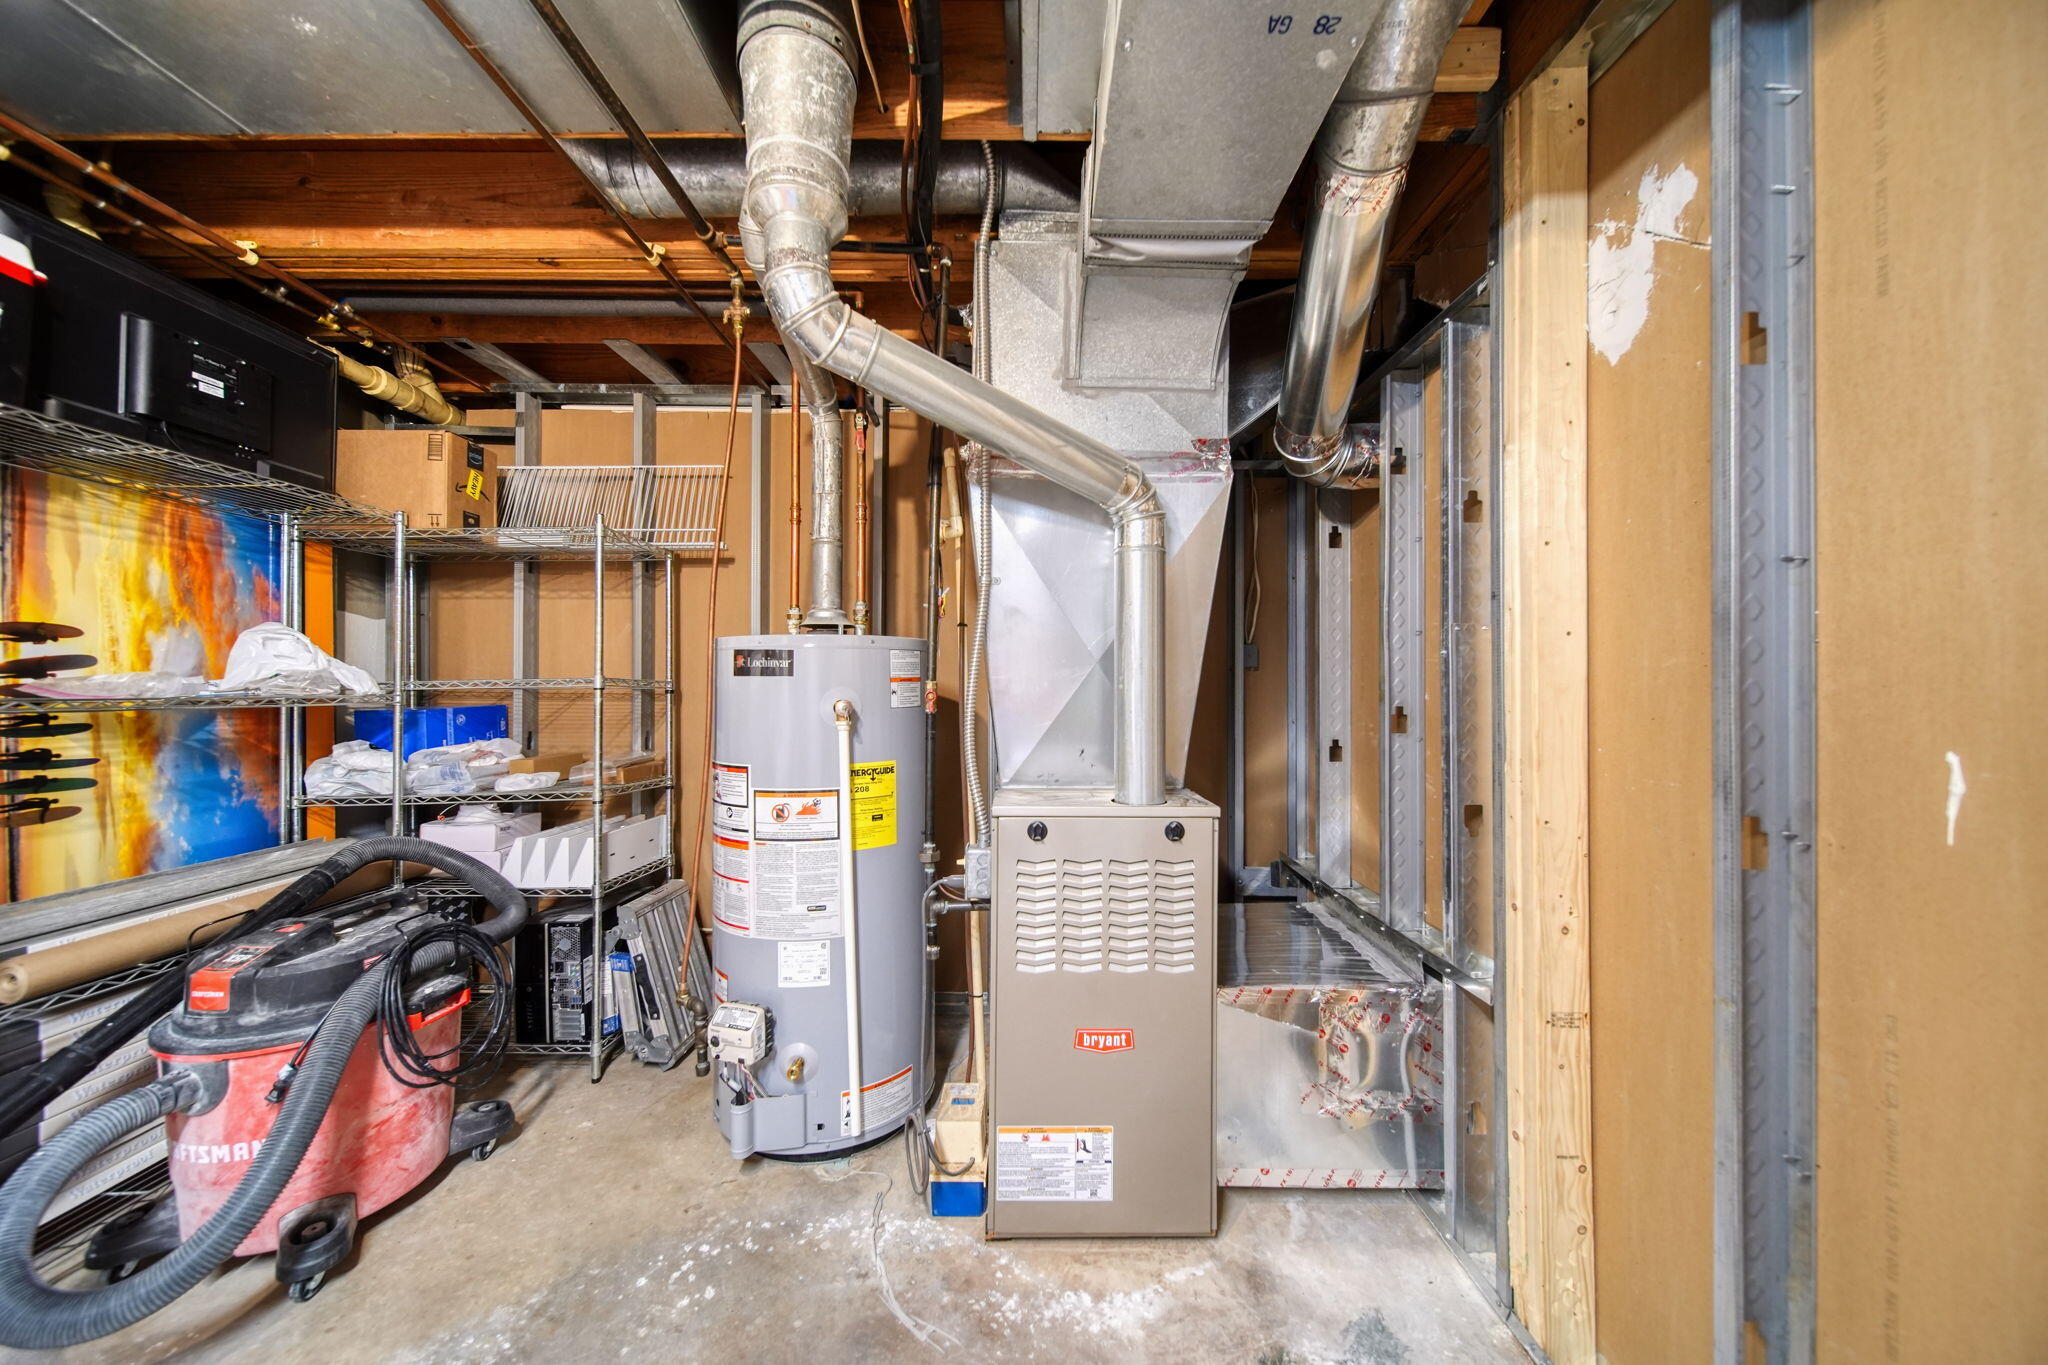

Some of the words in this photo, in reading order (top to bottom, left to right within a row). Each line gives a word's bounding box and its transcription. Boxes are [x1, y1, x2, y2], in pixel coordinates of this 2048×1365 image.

[1268, 14, 1293, 34] GA
[1313, 15, 1342, 35] 28
[470, 472, 480, 498] HEAVY
[747, 657, 792, 668] Lochinvar
[850, 766, 895, 780] NERGYGUIDE
[1083, 1033, 1127, 1048] bryant
